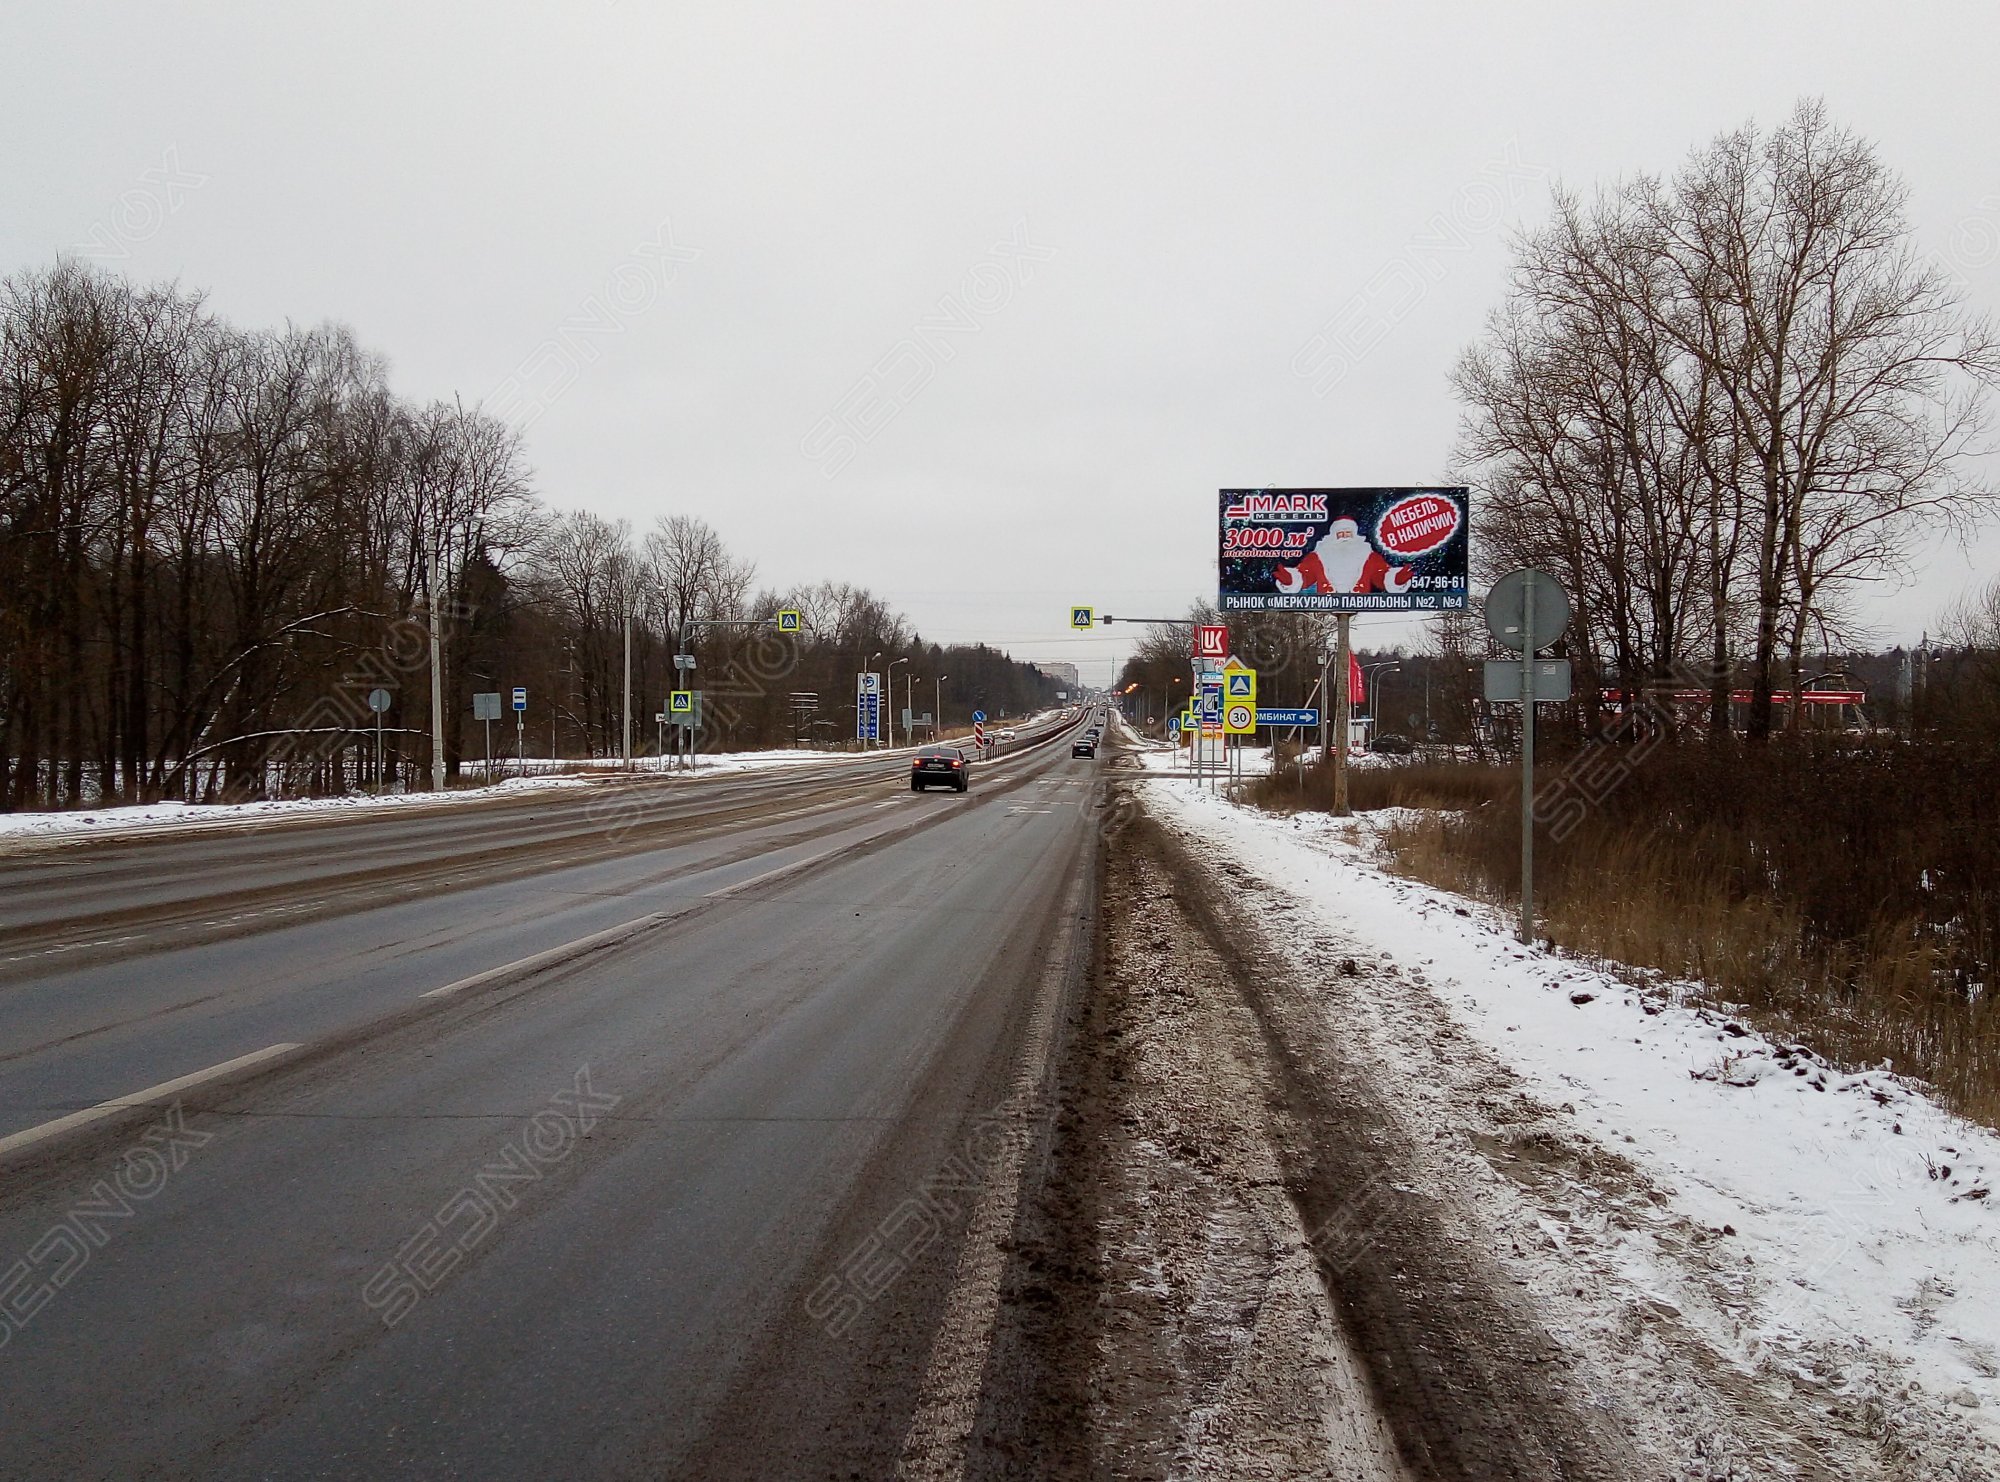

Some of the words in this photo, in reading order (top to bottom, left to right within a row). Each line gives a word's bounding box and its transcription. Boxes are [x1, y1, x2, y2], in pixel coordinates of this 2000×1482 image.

[1390, 500, 1439, 528] МЕБЕЛЬ
[1387, 532, 1398, 547] В
[1397, 510, 1455, 544] НАЛИЧИИ
[1223, 528, 1284, 550] 3000
[1222, 549, 1280, 559] выгодных
[1281, 549, 1303, 559] цен
[1411, 575, 1465, 589] 547-96-61
[1226, 596, 1265, 609] РЫНОК
[1267, 594, 1339, 608] «МЕРКУРИЙ»
[1341, 596, 1411, 608] ПАВИЛЬОНЫ
[1416, 596, 1439, 609] №2,
[1442, 596, 1463, 608] №4
[1232, 712, 1247, 723] 30
